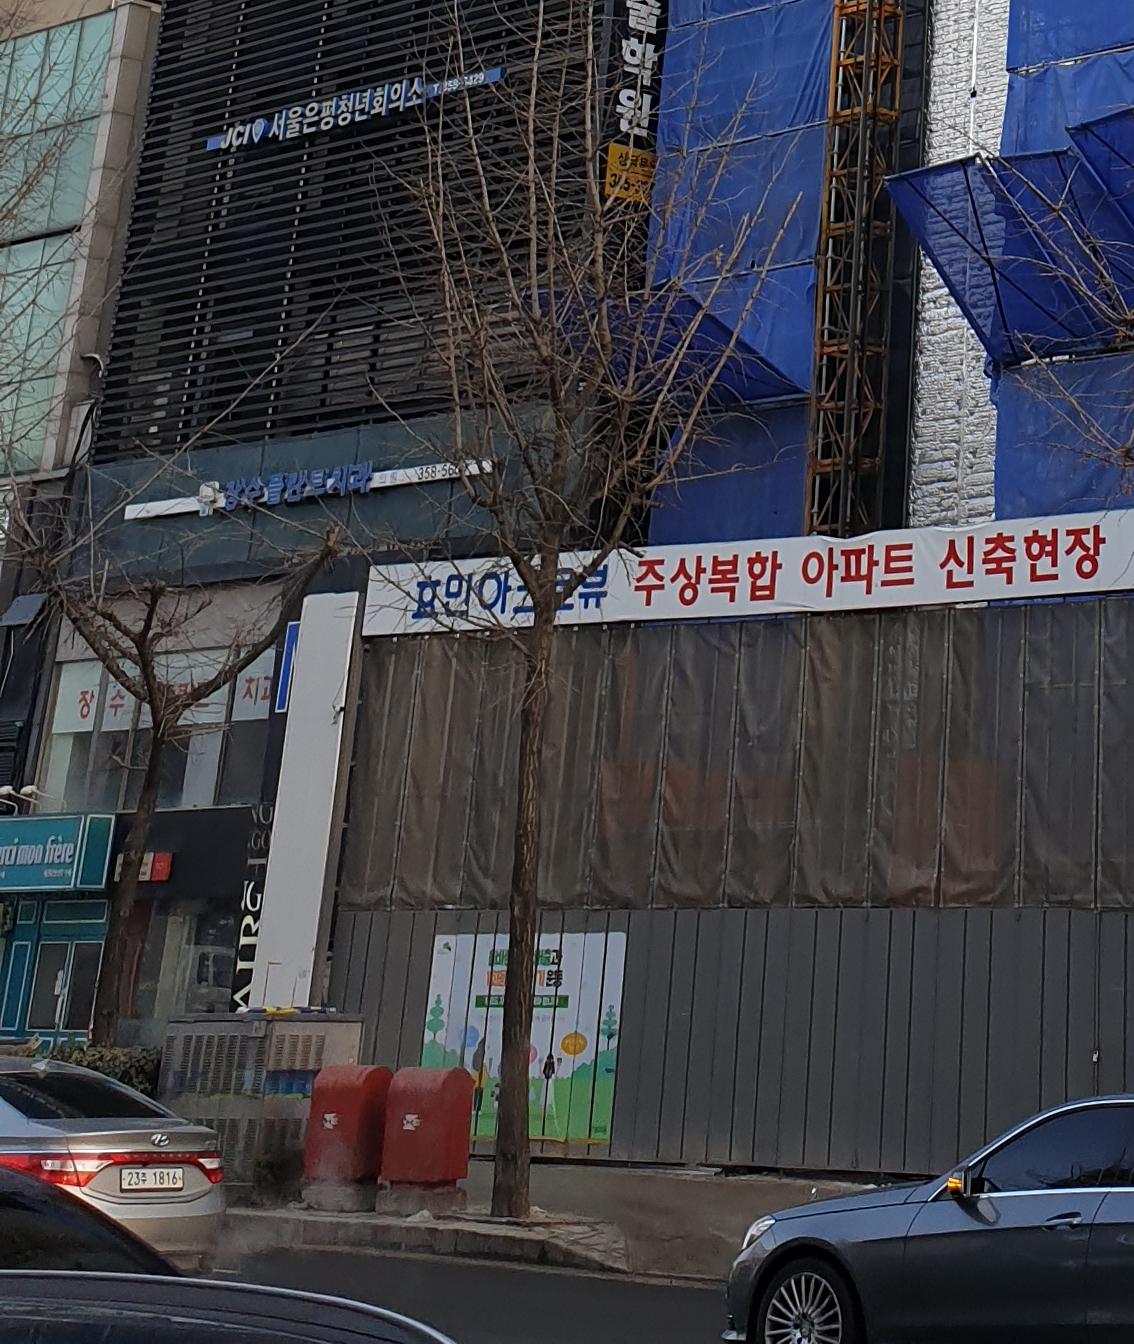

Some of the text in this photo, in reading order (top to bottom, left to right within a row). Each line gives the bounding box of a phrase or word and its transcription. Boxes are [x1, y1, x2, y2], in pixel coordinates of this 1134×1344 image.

[268, 76, 425, 142] 서울은평청년회의소
[220, 123, 252, 150] JCI
[633, 550, 783, 607] 주상복합
[801, 543, 915, 598] 아파트
[938, 524, 1107, 590] 신축현장
[152, 1170, 178, 1186] 1816
